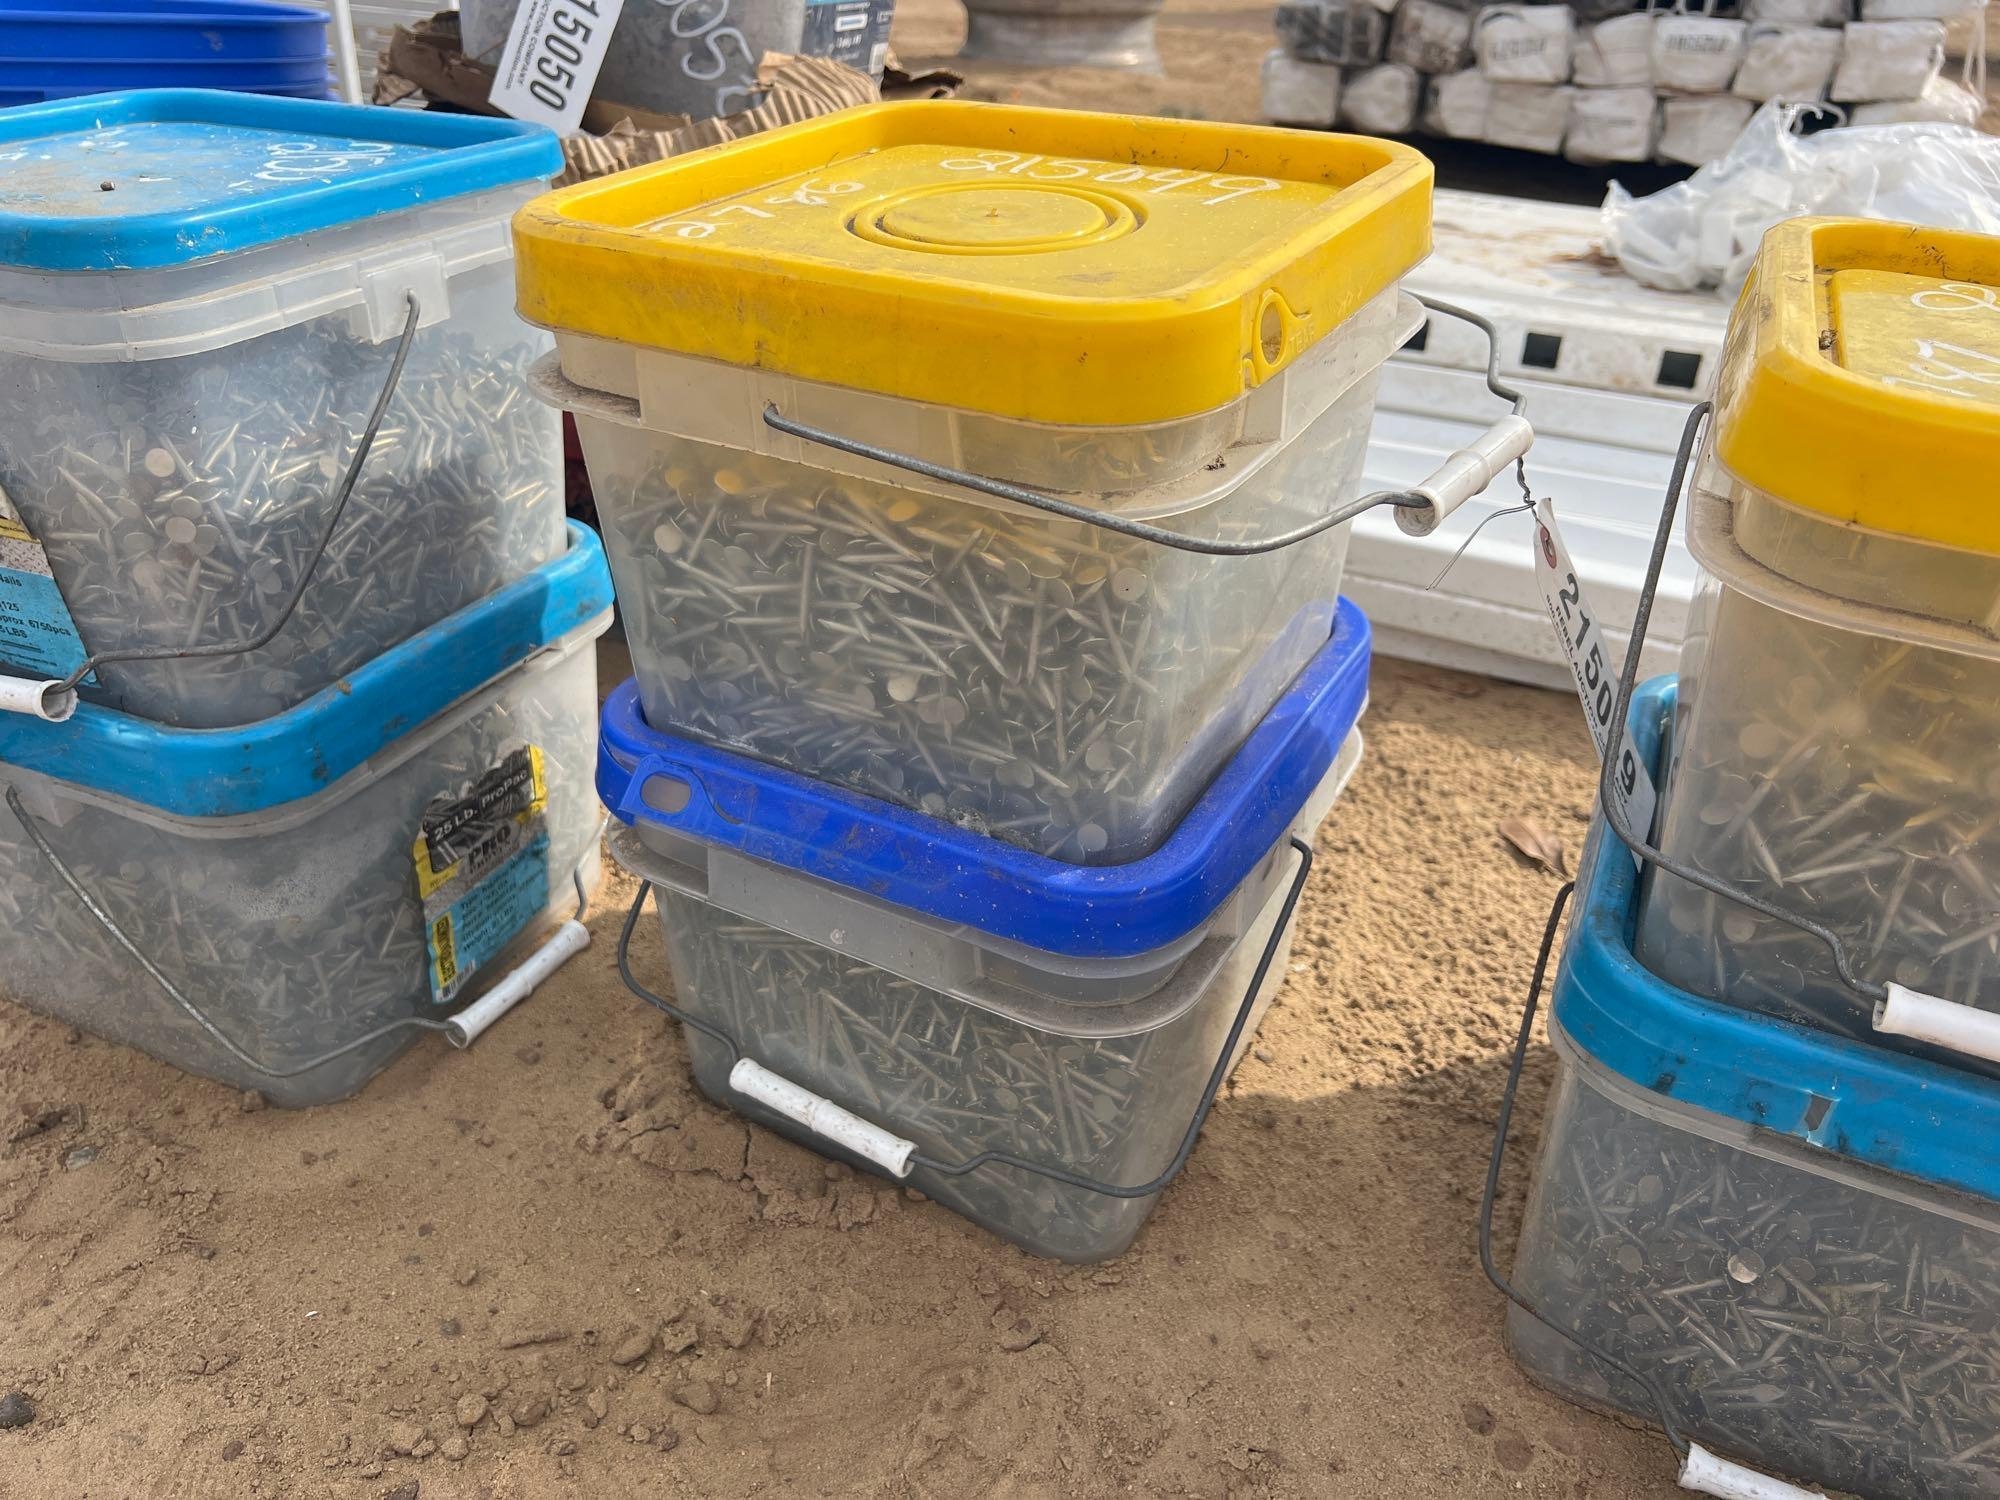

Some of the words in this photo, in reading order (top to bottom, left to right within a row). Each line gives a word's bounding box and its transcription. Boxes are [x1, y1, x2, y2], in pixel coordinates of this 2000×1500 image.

[939, 152, 1283, 206] 215049
[1555, 605, 1574, 659] REBEL
[1573, 662, 1598, 729] AUCTION
[1559, 573, 1636, 796] 21509
[434, 822, 454, 842] 25
[454, 807, 478, 828] Lb.
[481, 769, 529, 809] ProPac
